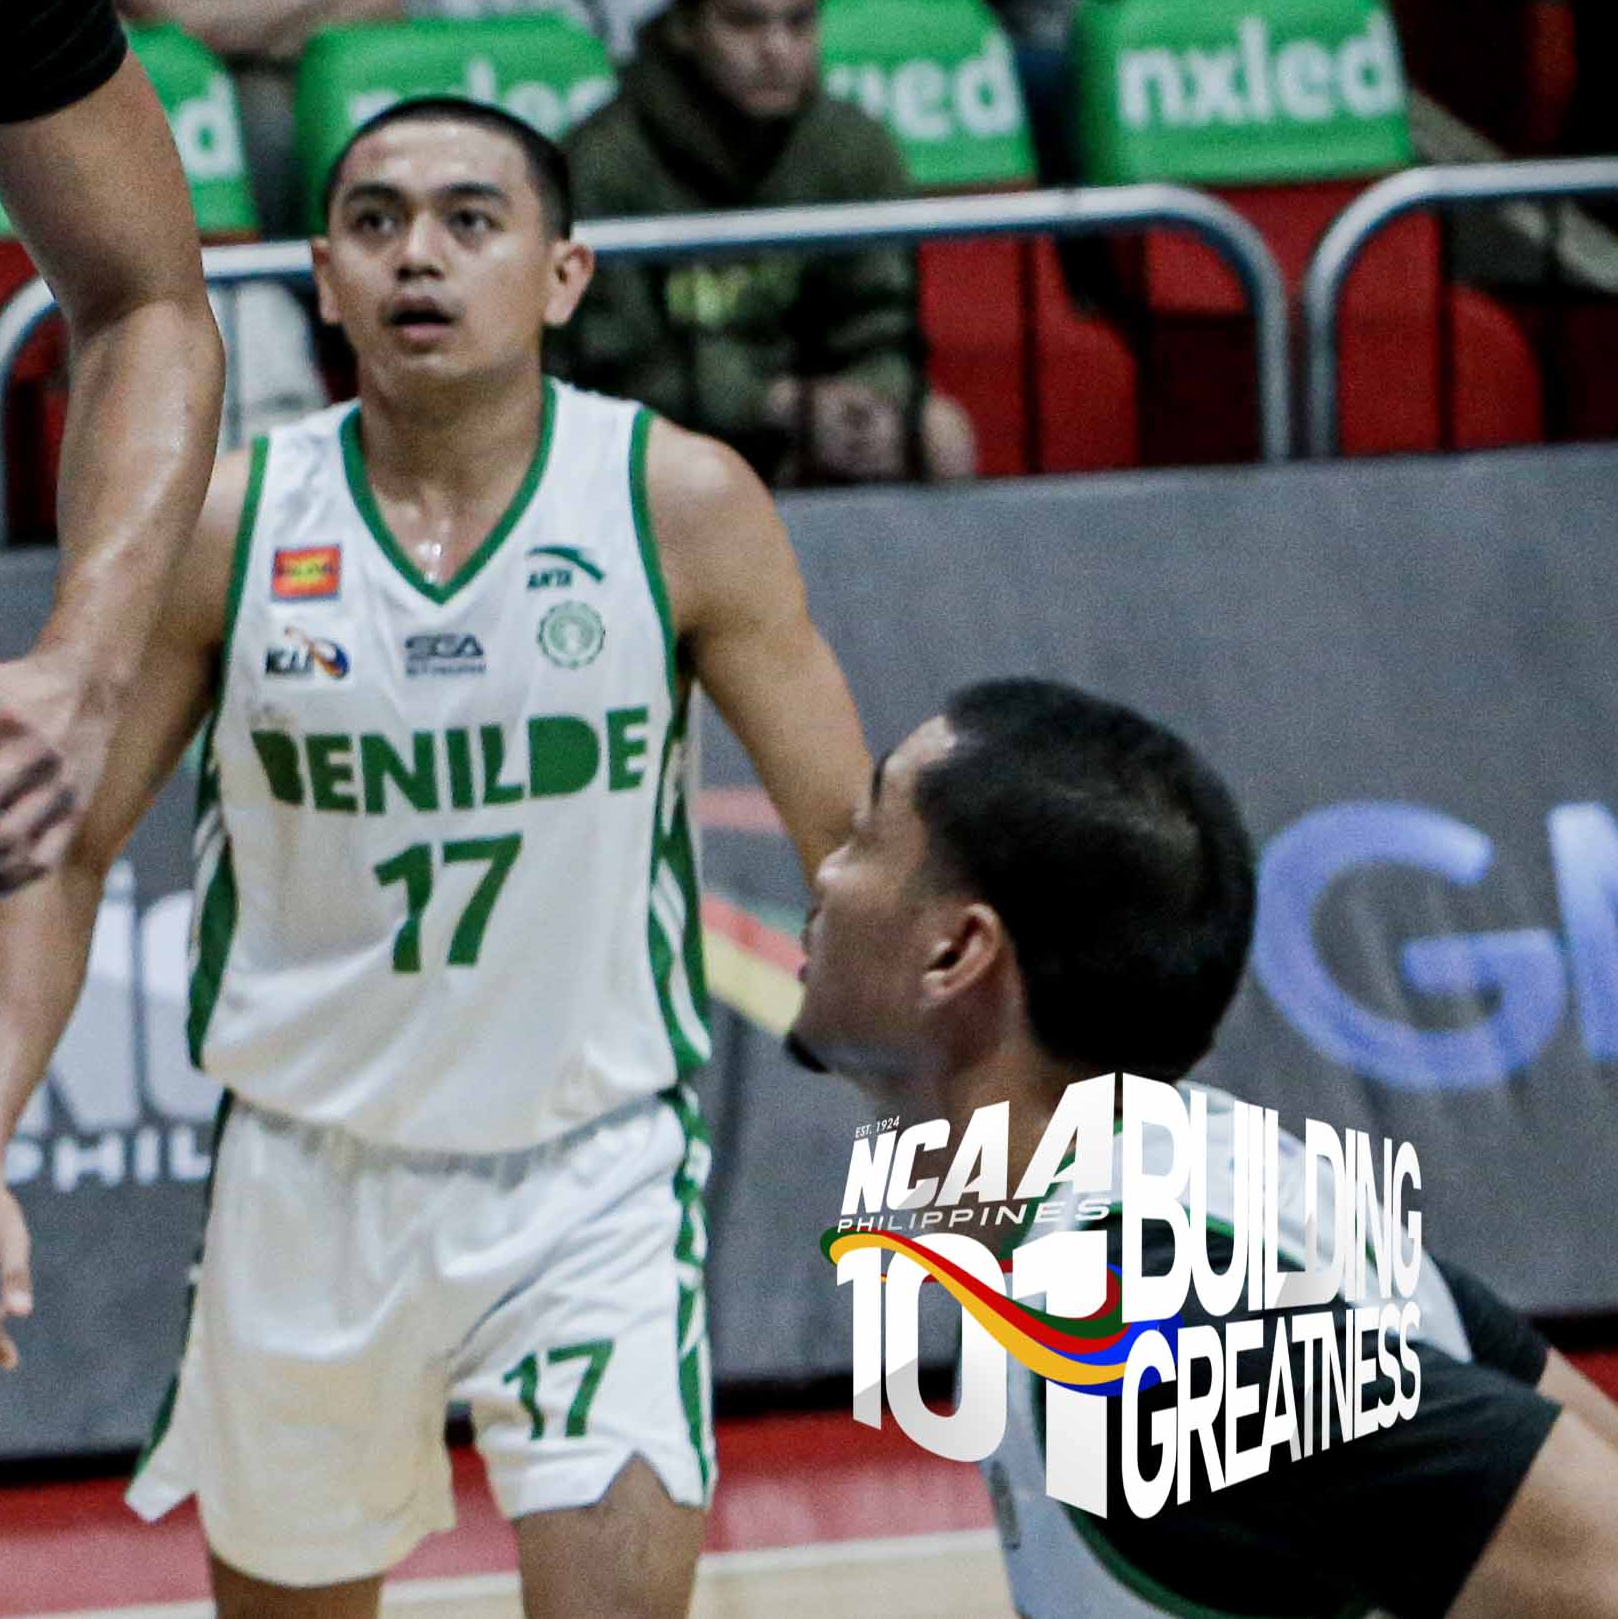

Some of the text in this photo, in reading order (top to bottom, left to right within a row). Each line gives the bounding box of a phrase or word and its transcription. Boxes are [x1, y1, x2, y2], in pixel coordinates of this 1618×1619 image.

[1117, 7, 1405, 128] nxled
[374, 831, 524, 973] 17
[502, 1339, 615, 1442] 17
